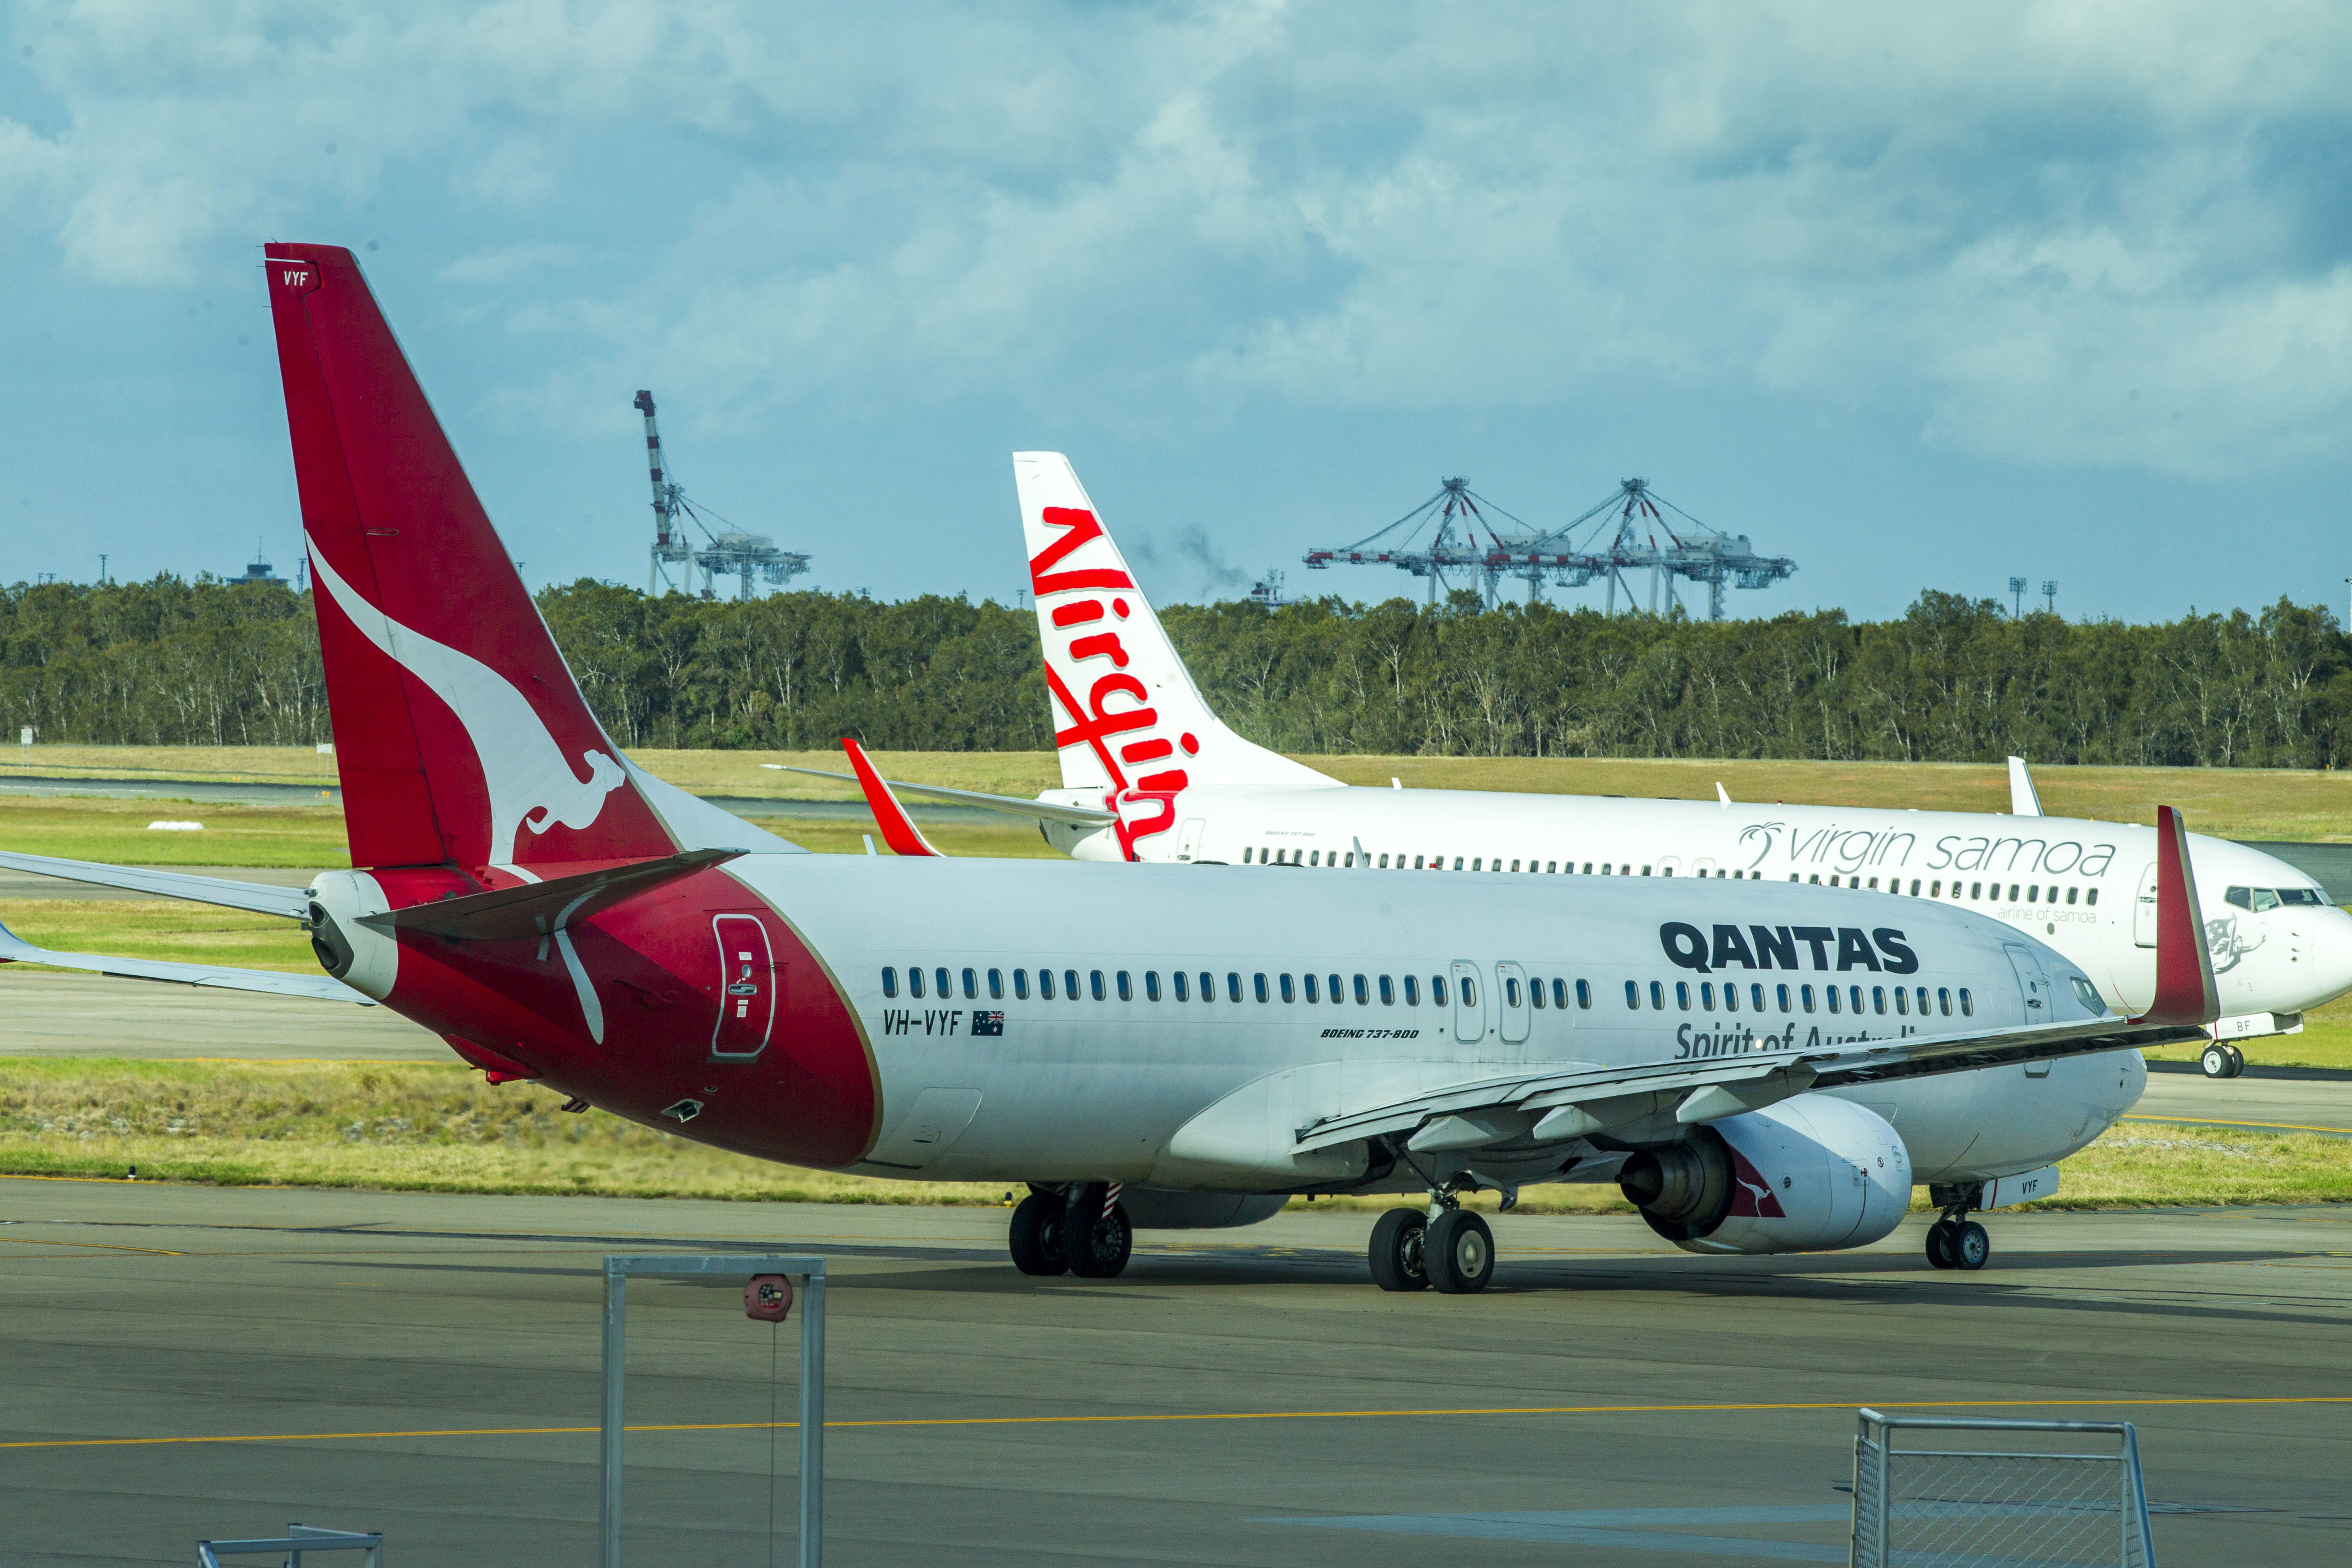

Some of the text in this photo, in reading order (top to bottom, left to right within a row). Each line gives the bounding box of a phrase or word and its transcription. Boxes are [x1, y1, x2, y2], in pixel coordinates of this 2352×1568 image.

[284, 271, 308, 286] VYF
[1790, 823, 2116, 877] virgin samoa
[1998, 905, 2096, 923] airline of samoa
[1659, 921, 1919, 975] QANTAS
[884, 1009, 963, 1036] VH-VYF
[1320, 1029, 1420, 1039] BOEING 737-800
[1674, 1022, 1754, 1060] Spirit
[1762, 1022, 1795, 1052] of
[2022, 1179, 2038, 1194] VYF
